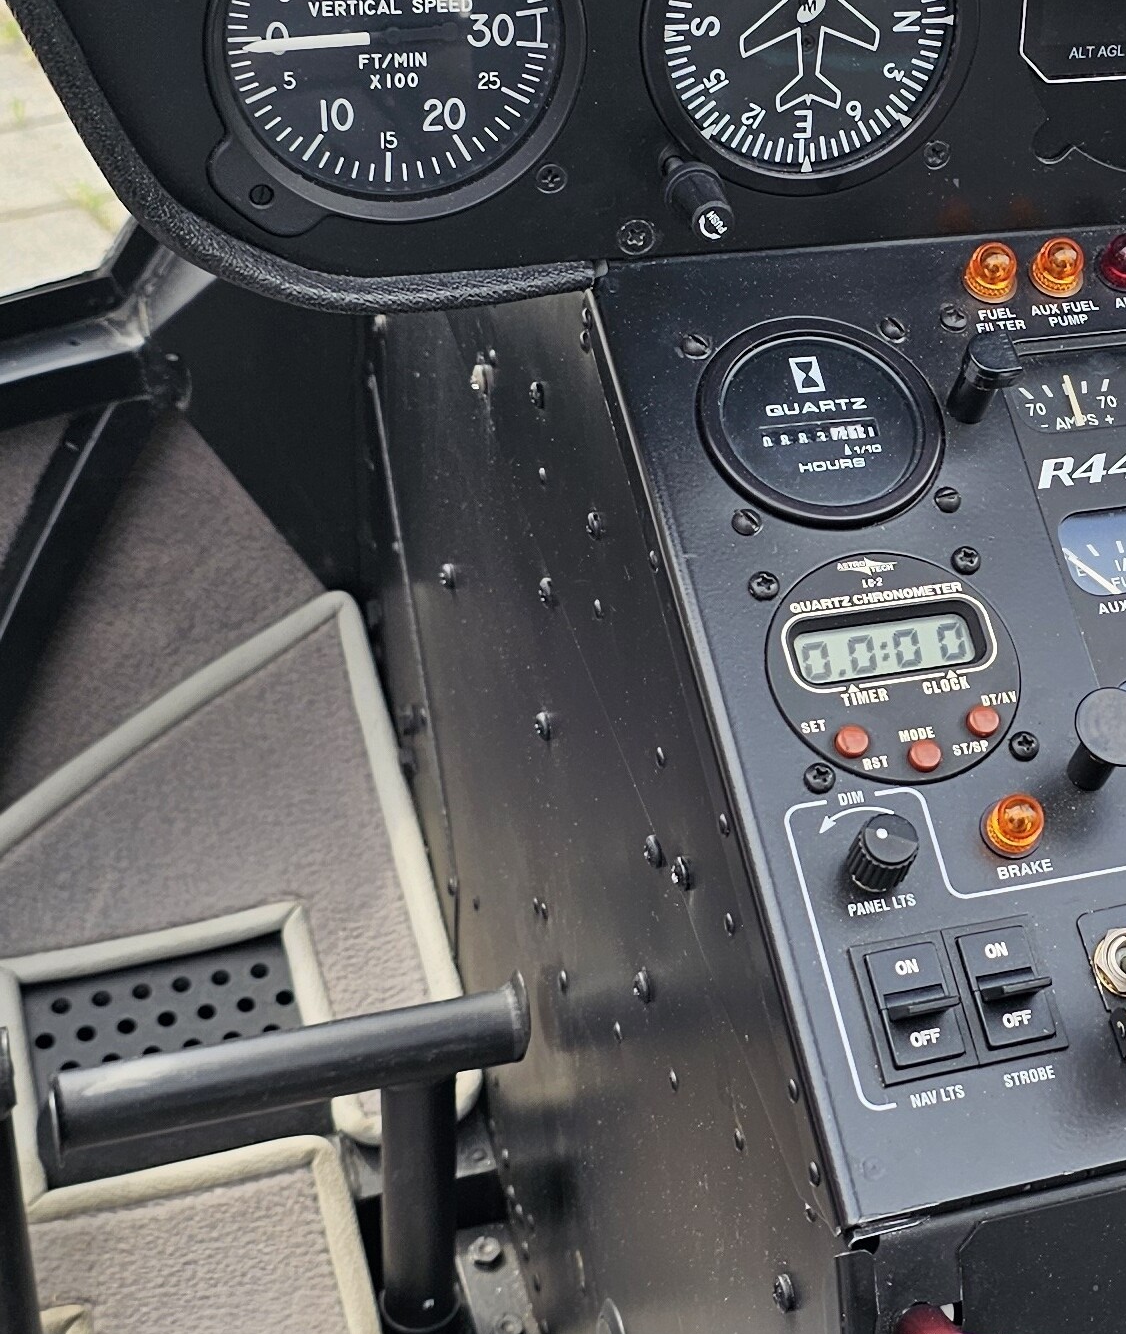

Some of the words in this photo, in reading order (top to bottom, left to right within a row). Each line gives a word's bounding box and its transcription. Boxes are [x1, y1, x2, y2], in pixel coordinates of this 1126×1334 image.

[307, 0, 402, 17] VERTICAL
[467, 13, 514, 47] 30
[358, 52, 428, 69] FT/MIN
[1069, 46, 1096, 59] ALT
[1097, 45, 1125, 58] AGL
[369, 73, 419, 89] X100
[978, 308, 1017, 321] FUEL
[1031, 304, 1061, 317] AUX
[1063, 301, 1100, 314] FUEL
[1049, 314, 1089, 327] PUMP
[765, 398, 868, 416] QUARTZ
[799, 458, 866, 473] HOURS
[790, 595, 852, 614] QUARTZ
[852, 582, 963, 605] CHRONOMETER
[922, 676, 970, 695] CLOCK
[841, 687, 889, 707] TIMER
[801, 719, 826, 734] SET
[898, 727, 935, 743] MODE
[862, 755, 889, 771] RST
[837, 791, 865, 806] DIM
[997, 859, 1054, 880] BRAKE
[848, 899, 890, 917] PANEL
[891, 893, 916, 909] LTS
[984, 942, 1009, 959] ON
[895, 958, 919, 975] ON
[1002, 1009, 1032, 1028] OFF
[909, 1028, 941, 1047] OFF
[1003, 1065, 1056, 1088] STROBE
[910, 1091, 938, 1108] NAV
[939, 1084, 965, 1101] LTS
